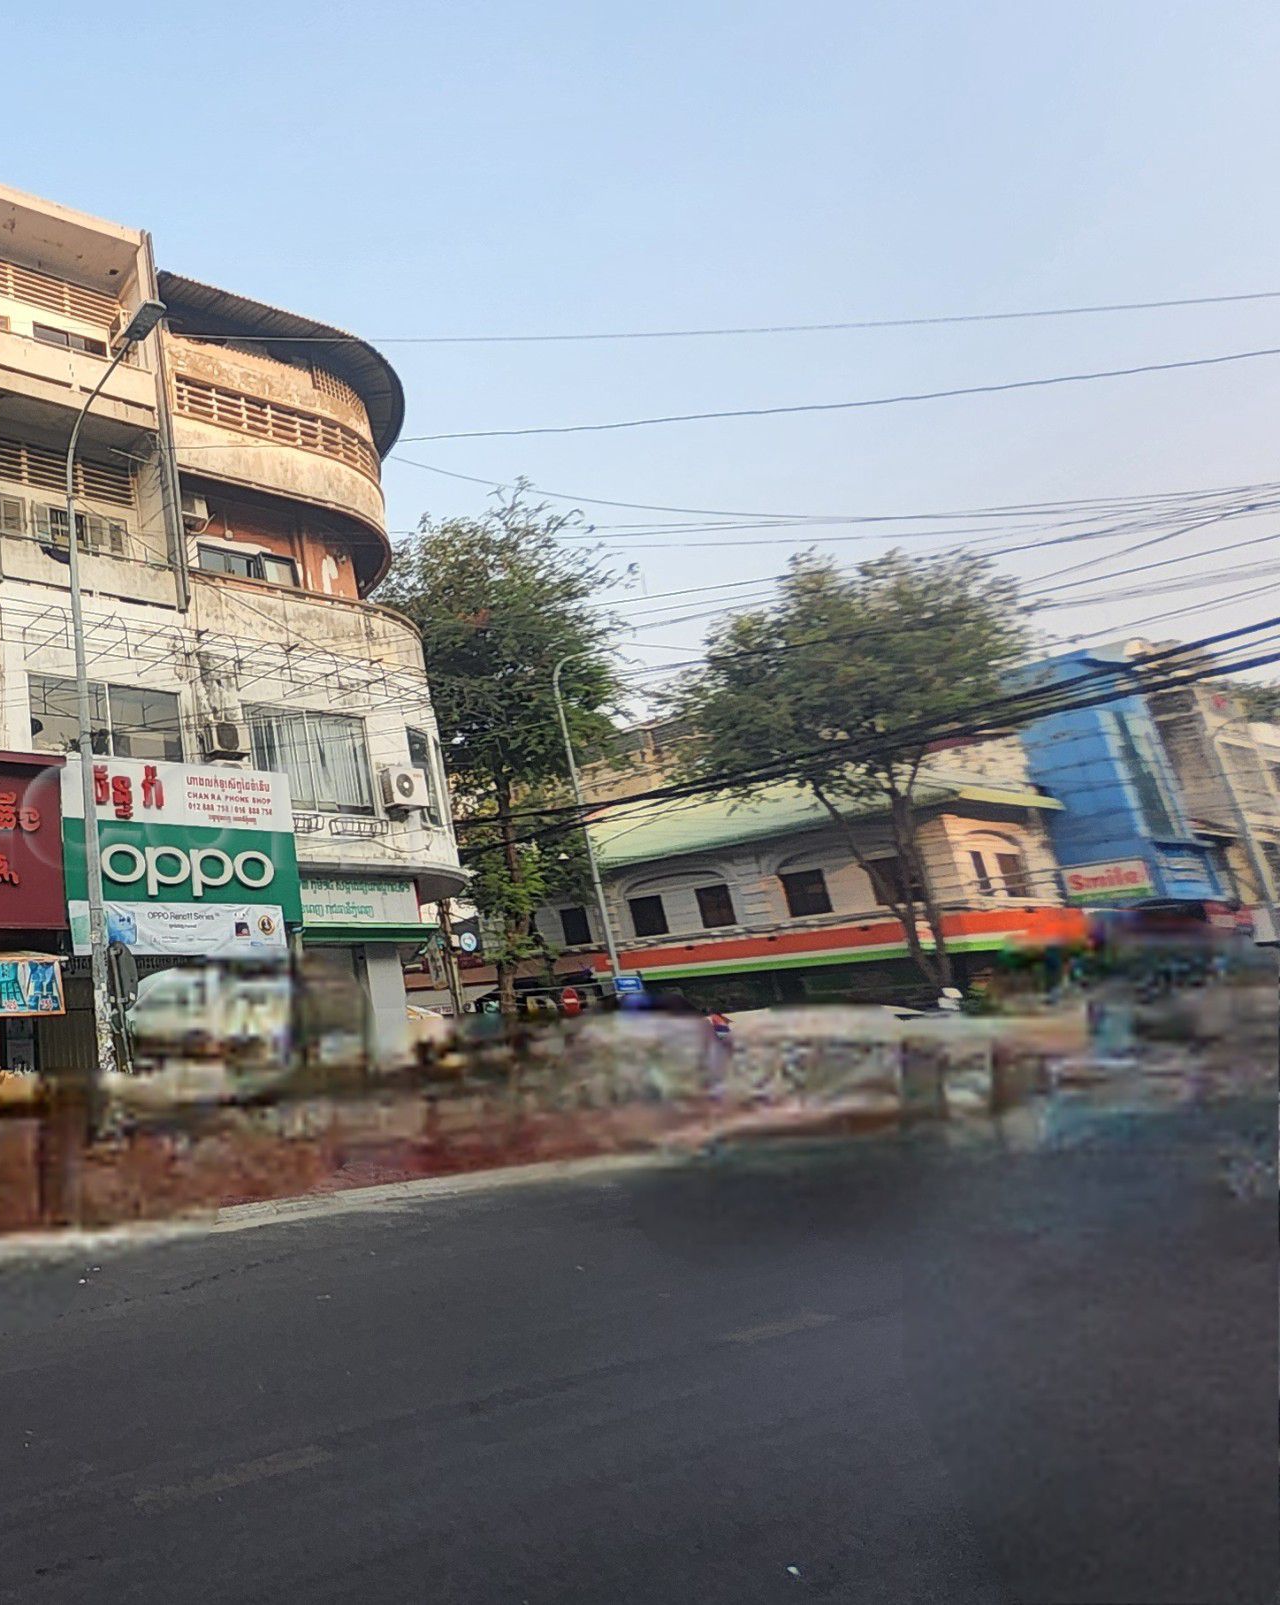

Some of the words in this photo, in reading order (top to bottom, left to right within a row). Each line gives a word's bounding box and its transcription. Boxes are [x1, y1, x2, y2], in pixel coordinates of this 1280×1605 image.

[224, 795, 249, 804] PHONE
[252, 796, 272, 805] SHOP
[187, 802, 201, 811] 012
[1068, 867, 1139, 891] Smile
[147, 911, 169, 921] OPPO
[193, 912, 215, 921] Series
